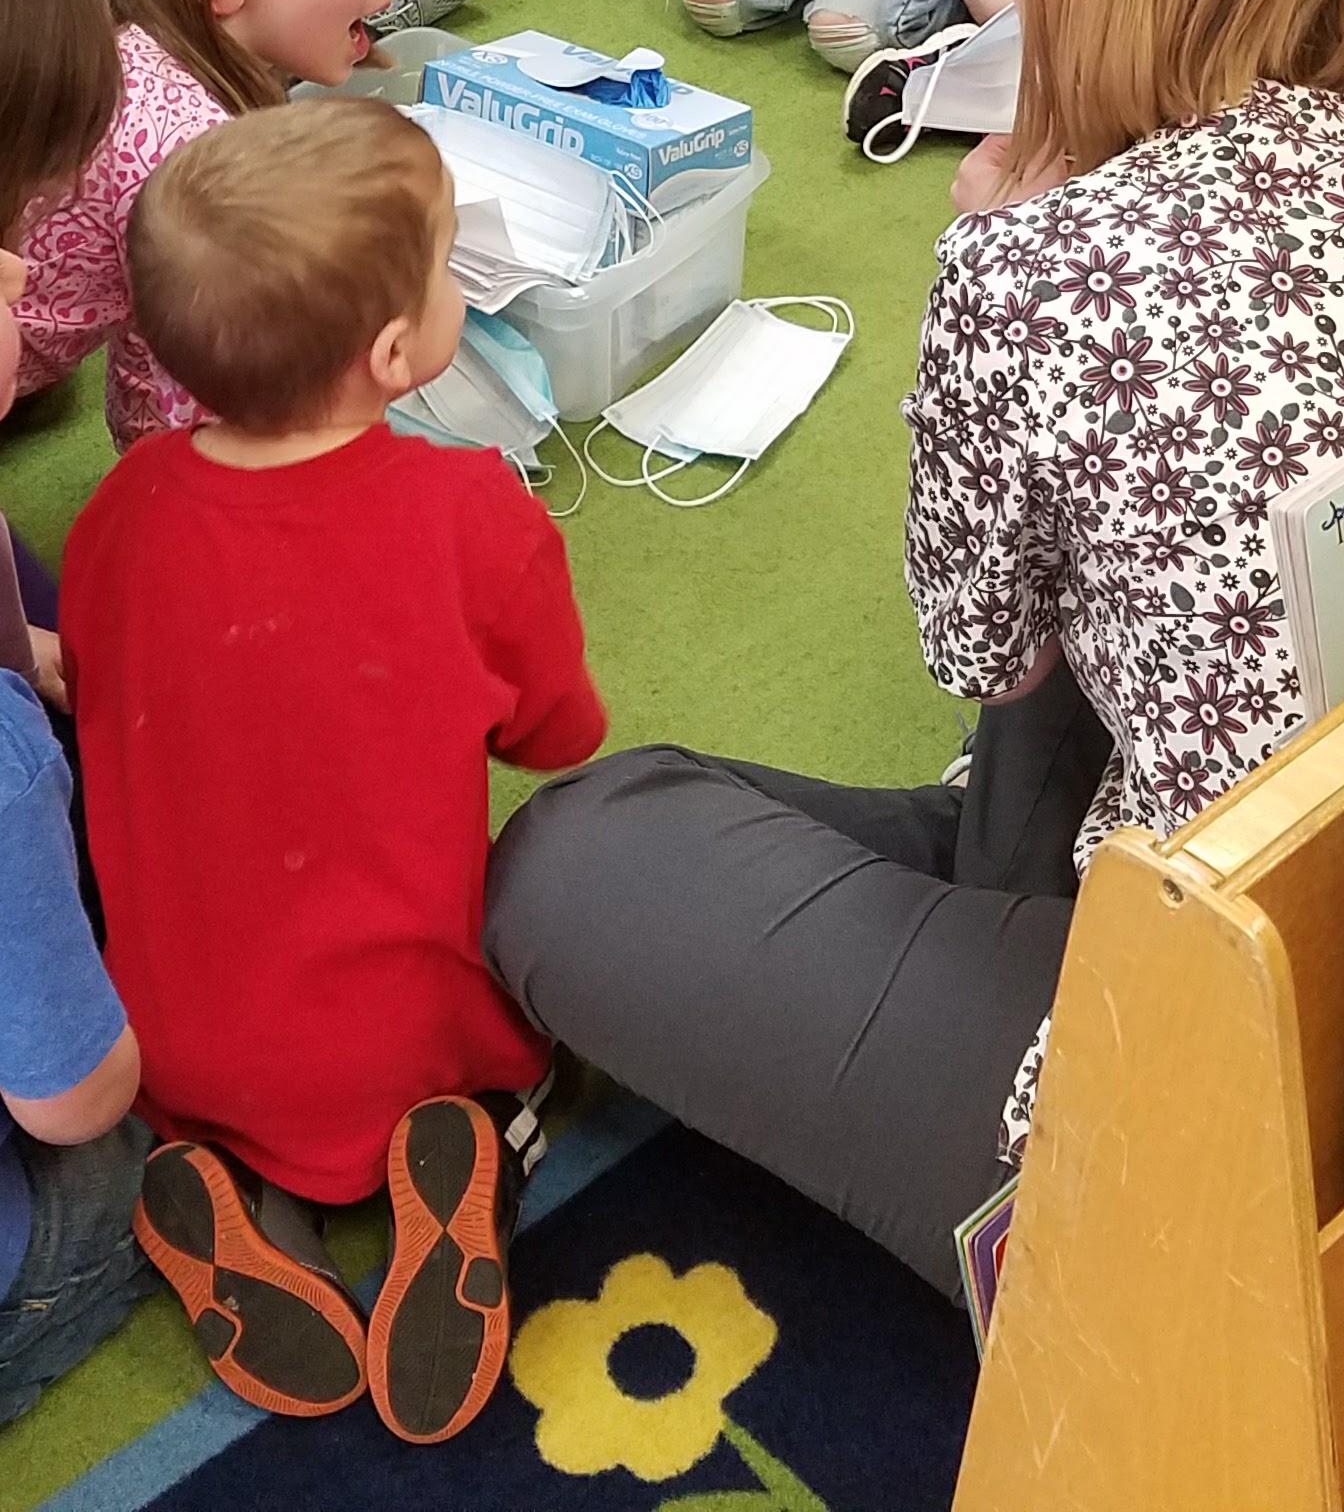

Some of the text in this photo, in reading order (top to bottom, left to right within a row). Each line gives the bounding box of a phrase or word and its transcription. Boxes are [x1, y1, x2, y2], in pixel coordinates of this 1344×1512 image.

[437, 71, 585, 158] ValuGrip
[657, 127, 725, 166] ValuGrip
[735, 142, 749, 155] XS
[625, 165, 642, 176] XS
